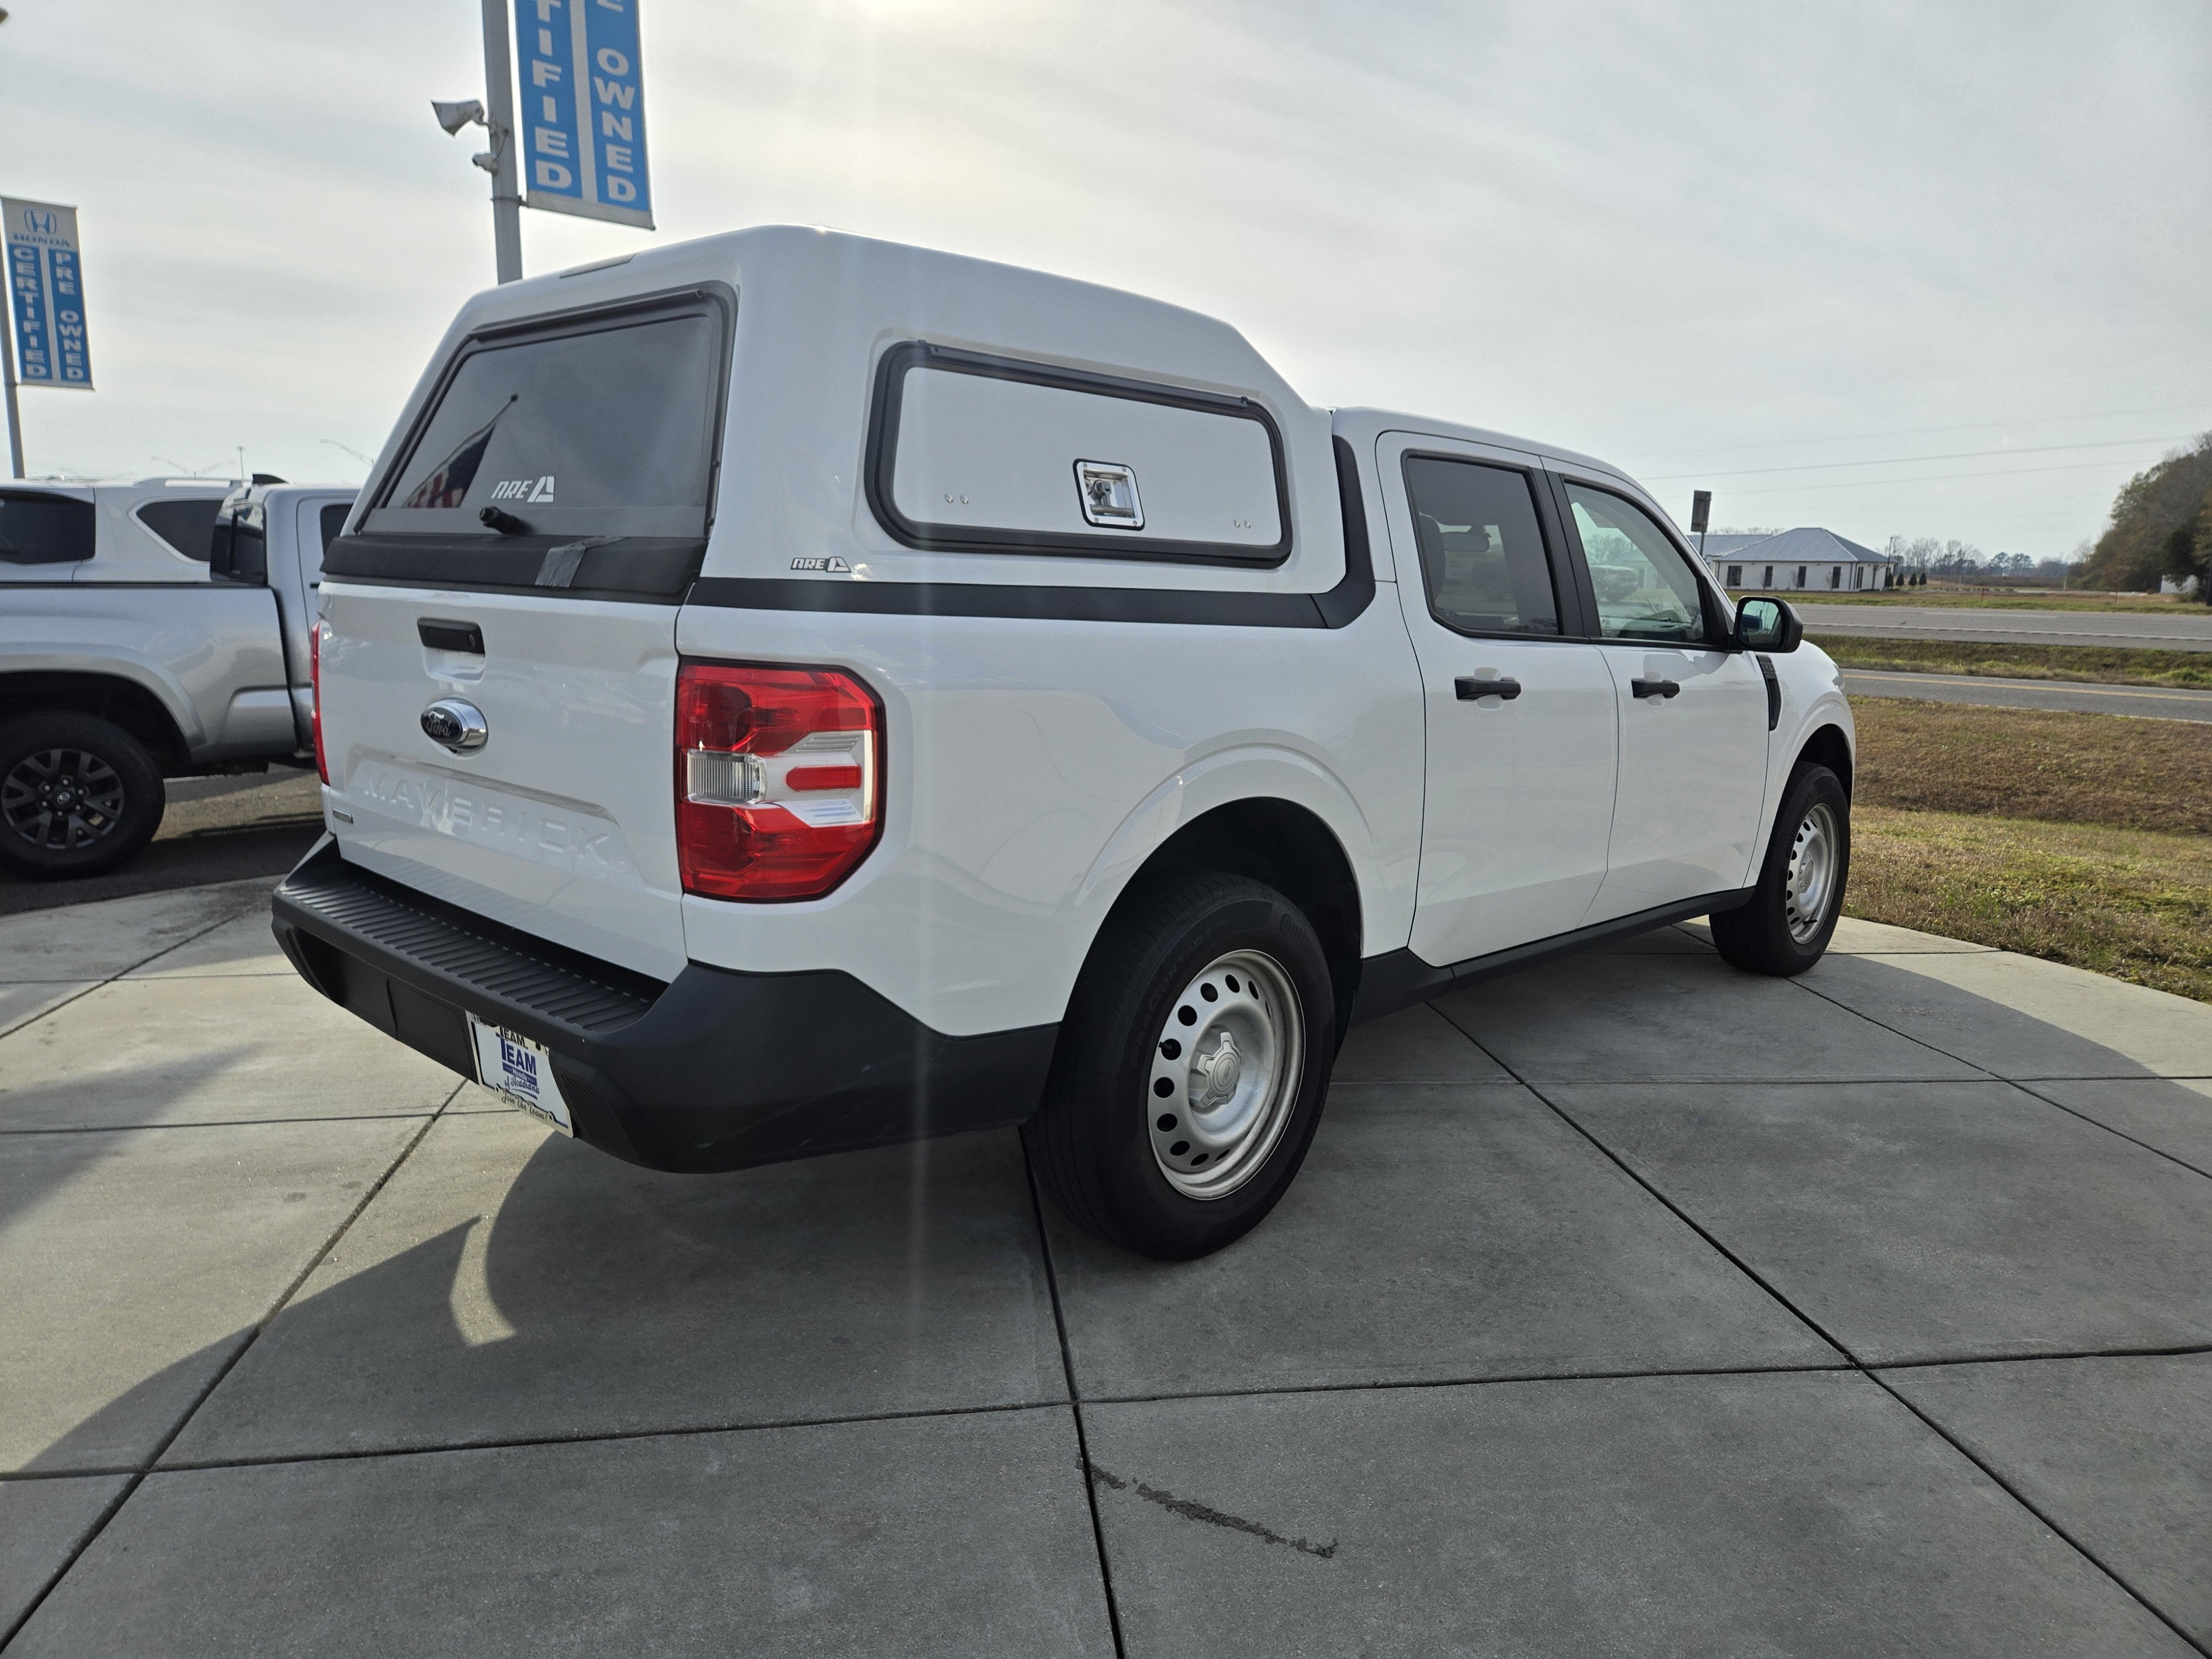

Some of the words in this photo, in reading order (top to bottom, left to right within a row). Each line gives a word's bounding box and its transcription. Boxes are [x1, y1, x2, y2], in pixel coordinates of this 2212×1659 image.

[593, 48, 637, 202] OWNED
[13, 233, 71, 247] HONDA
[56, 252, 75, 295] PRE
[13, 247, 47, 379] CERTIFIED
[59, 309, 84, 380] OWNED
[491, 479, 533, 499] ARE
[791, 557, 826, 570] ARE
[426, 710, 452, 738] Ford
[363, 774, 609, 865] MAVERICK
[502, 1090, 515, 1104] Join
